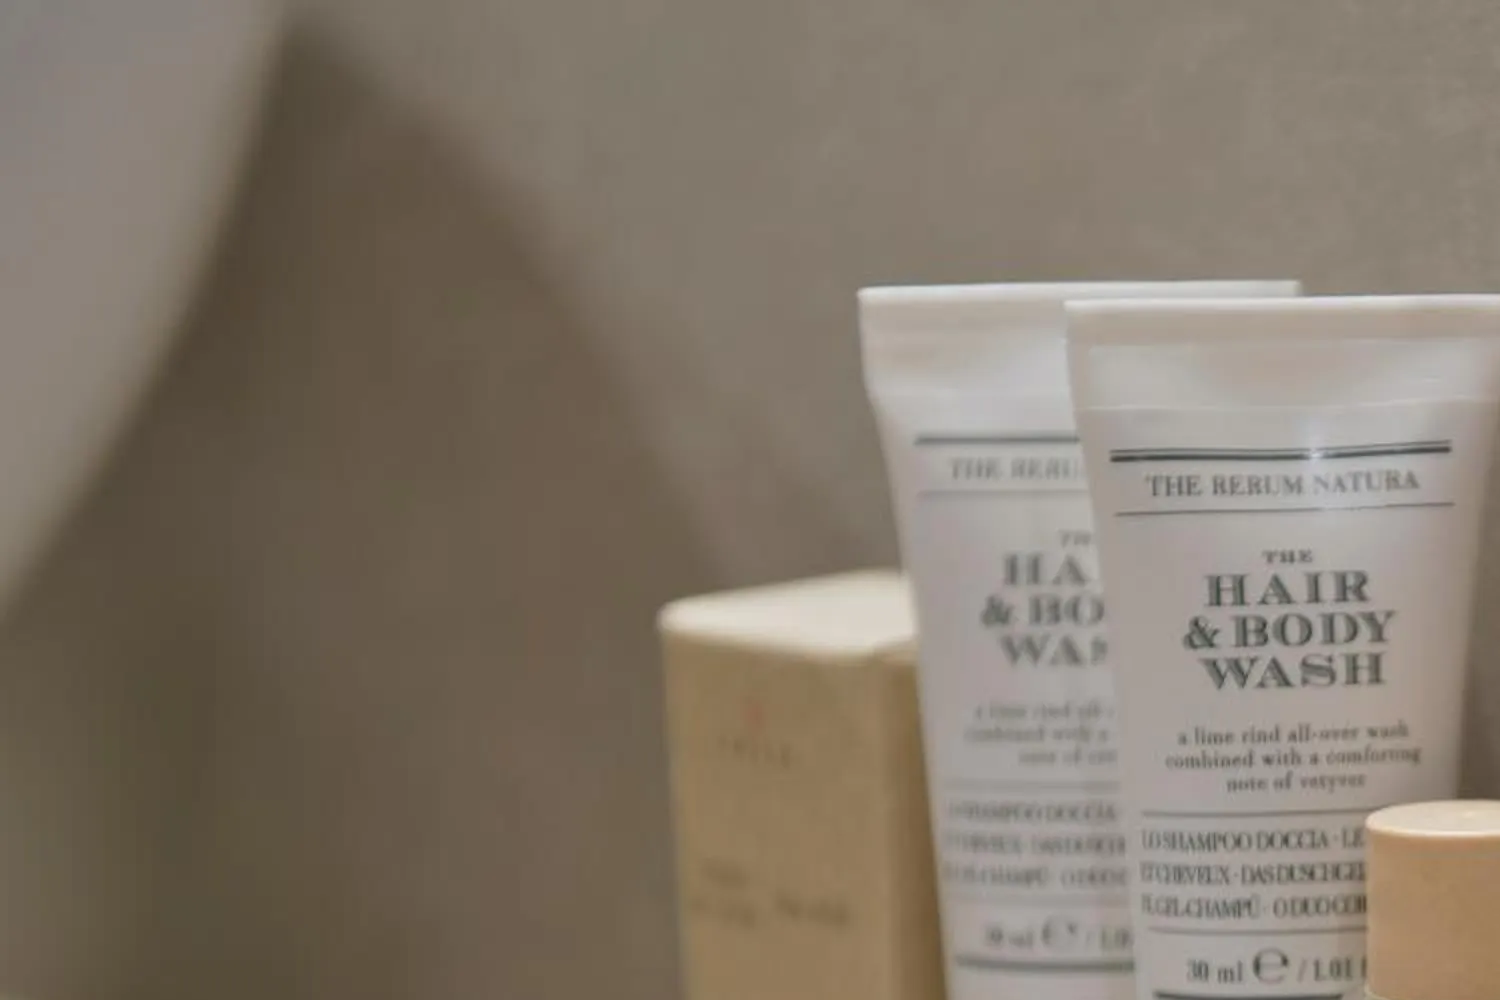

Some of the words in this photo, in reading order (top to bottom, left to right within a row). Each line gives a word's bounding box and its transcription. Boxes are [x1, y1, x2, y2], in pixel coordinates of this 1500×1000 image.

[1145, 474, 1202, 498] THE
[1212, 472, 1304, 497] RERUM
[1311, 468, 1420, 494] NATURA
[1002, 552, 1092, 587] HA
[1262, 549, 1315, 566] THE
[1205, 569, 1372, 608] HAIR
[1027, 593, 1106, 627] BO
[1182, 615, 1221, 651] &
[1231, 609, 1397, 649] BODY
[1200, 651, 1388, 690] WASH
[1177, 733, 1188, 746] a
[1194, 726, 1234, 746] lime
[1241, 724, 1280, 744] rind
[1287, 722, 1360, 743] all-over
[1366, 720, 1409, 740] wash
[1165, 749, 1255, 771] combined
[1262, 747, 1303, 767] with
[1309, 753, 1320, 767] a
[1326, 746, 1422, 767] comforting
[1226, 775, 1267, 794] note
[1273, 771, 1293, 792] of
[1162, 829, 1252, 853] SHAMPOO
[1256, 829, 1329, 851] DOCCIA
[1241, 862, 1274, 886] DAS
[1186, 957, 1209, 983] 30
[1217, 958, 1243, 985] ml
